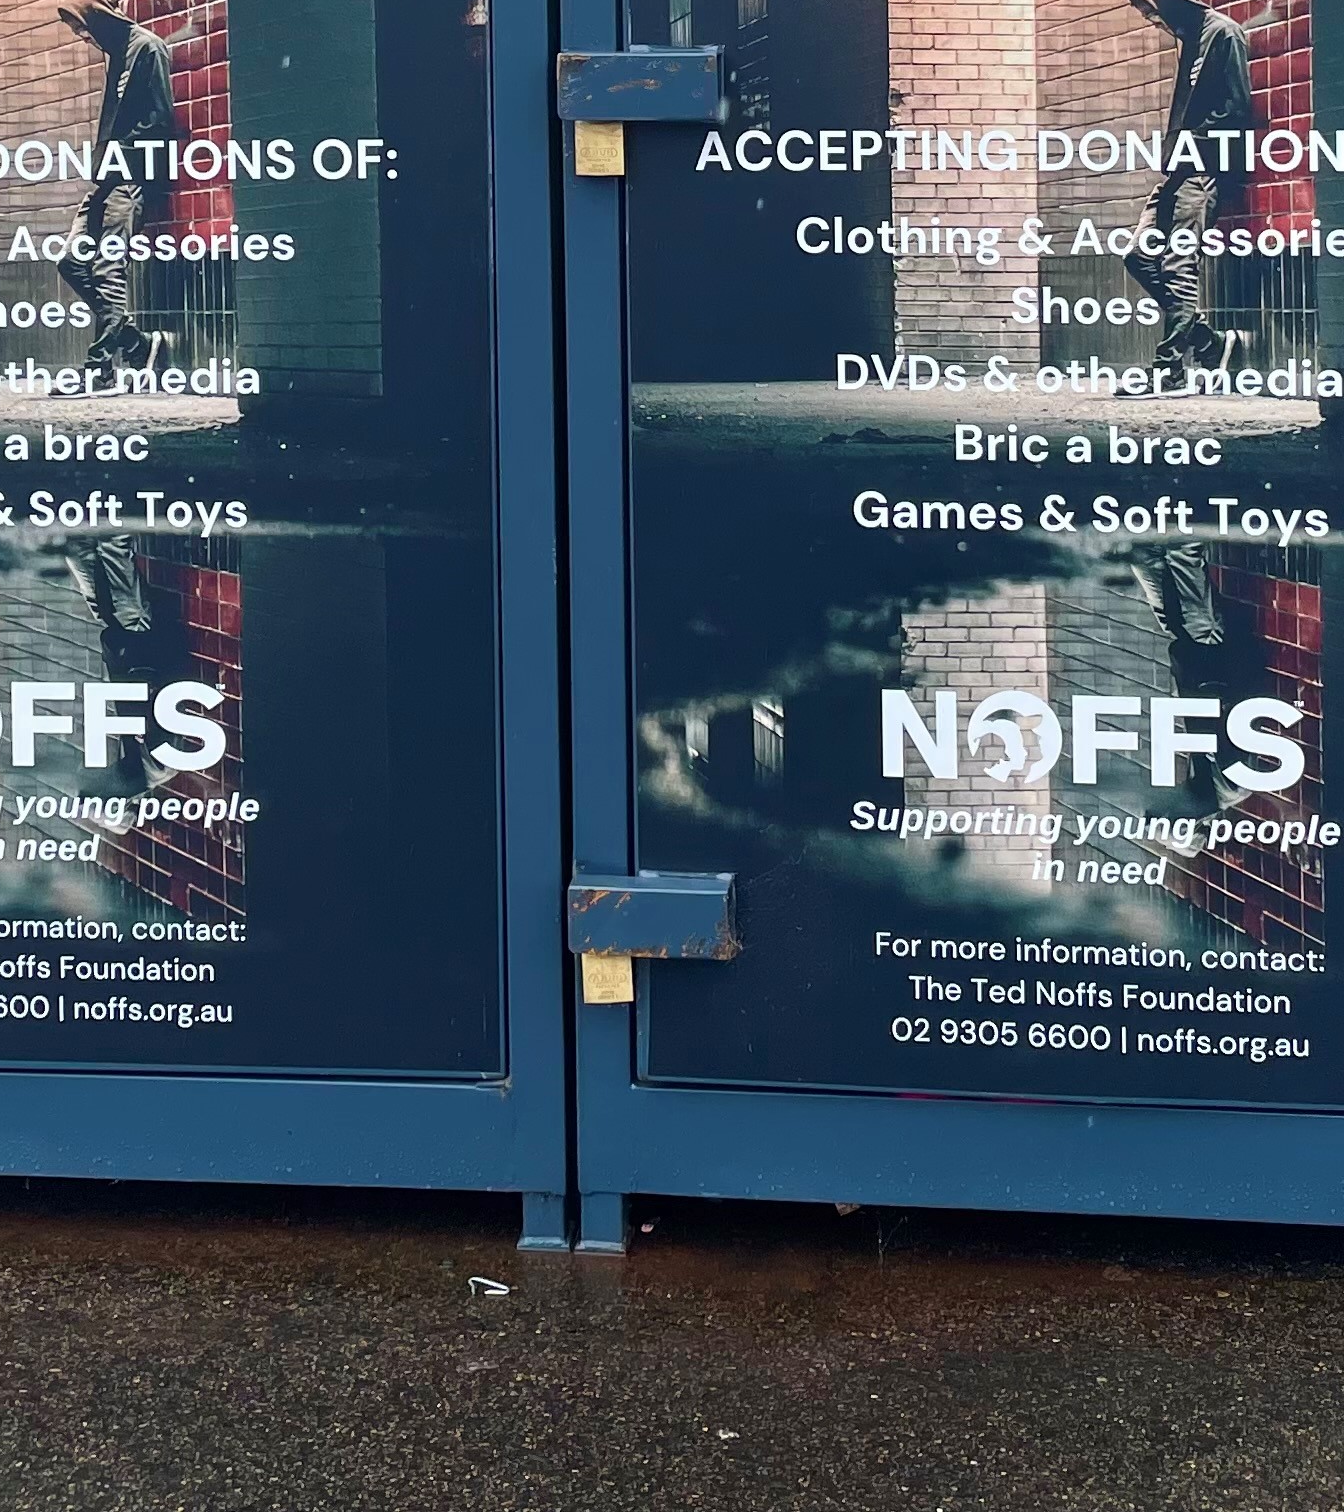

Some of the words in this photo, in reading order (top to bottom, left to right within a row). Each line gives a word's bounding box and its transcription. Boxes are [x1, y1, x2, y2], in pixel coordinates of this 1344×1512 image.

[312, 138, 399, 180] OF:
[695, 129, 1017, 172] ACCEPTING
[8, 224, 296, 262] Accessories
[796, 216, 1003, 266] Clothing
[1017, 217, 1054, 256] &
[1010, 286, 1160, 326] Shoes
[116, 358, 261, 396] media
[835, 353, 967, 391] DVDs
[983, 354, 1019, 393] &
[1036, 355, 1172, 395] other
[1188, 358, 1344, 398] media
[4, 435, 30, 462] a
[44, 426, 150, 462] brac
[955, 423, 1049, 463] Bric
[1065, 435, 1093, 464] a
[1109, 426, 1223, 467] brac
[29, 491, 123, 528] Soft
[136, 492, 249, 538] Toys
[853, 490, 1023, 531] Games
[1038, 493, 1075, 533] &
[1091, 495, 1194, 535] Soft
[1208, 497, 1330, 548] Toys
[881, 689, 1307, 792] NOFFS
[15, 794, 127, 827] young
[136, 791, 260, 829] people
[849, 800, 1062, 843] Supporting
[1073, 814, 1198, 849] young
[1206, 813, 1342, 853] people
[17, 833, 101, 862] need
[1031, 851, 1065, 882] in
[1077, 855, 1168, 886] need
[132, 920, 247, 943] contact:
[59, 955, 216, 982] Foundation
[875, 932, 922, 958] For
[931, 940, 1006, 961] more
[1016, 936, 1193, 972] information,
[1201, 948, 1326, 974] contact:
[73, 997, 233, 1028] noffs.org.au
[908, 975, 962, 1002] The
[971, 977, 1026, 1005] Ted
[1036, 981, 1113, 1009] Noffs
[1122, 984, 1291, 1014] Foundation
[891, 1017, 930, 1043] 02
[941, 1019, 1018, 1047] 9305
[1028, 1023, 1111, 1051] 6600
[1137, 1028, 1310, 1063] noffs.org.au
